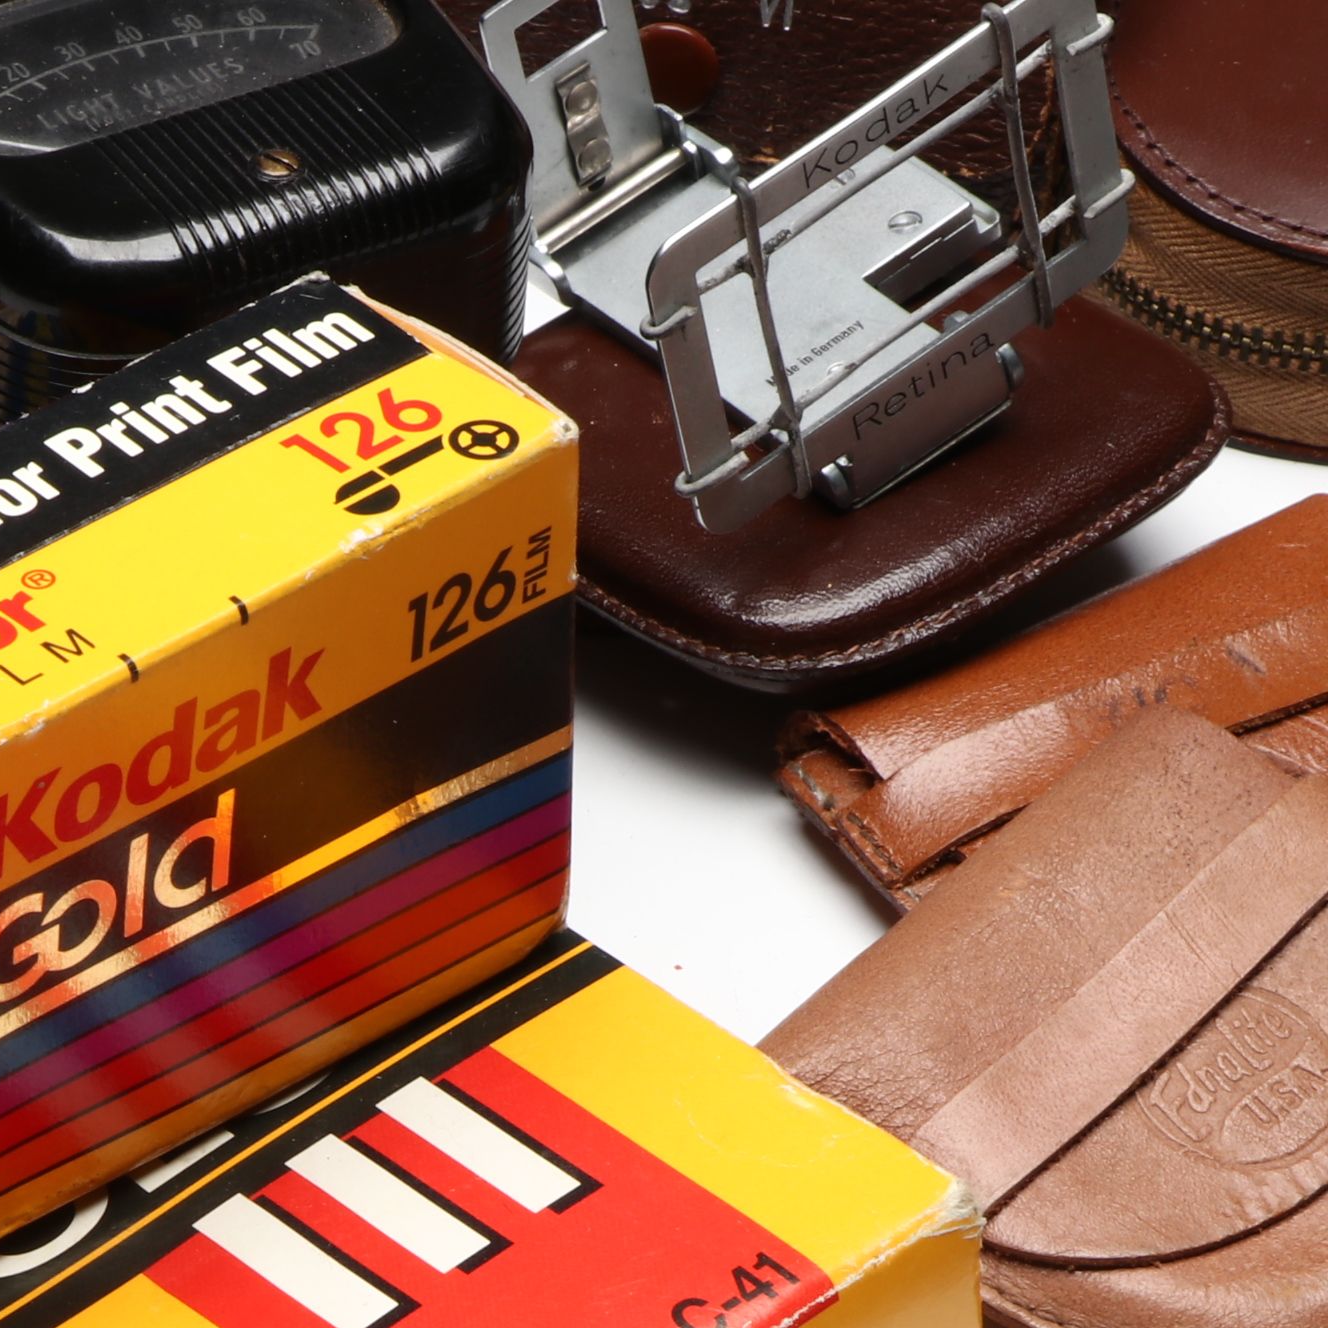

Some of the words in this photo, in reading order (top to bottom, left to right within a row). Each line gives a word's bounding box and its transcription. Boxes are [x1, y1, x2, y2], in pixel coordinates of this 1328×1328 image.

[115, 25, 143, 45] 40
[172, 14, 203, 33] 50
[236, 7, 267, 26] 60
[0, 61, 30, 83] 20
[54, 41, 86, 62] 30
[289, 40, 322, 59] 70
[36, 93, 121, 130] LIGHT
[131, 57, 246, 100] VALUES
[803, 71, 949, 192] Kodak
[797, 355, 814, 366] in
[810, 320, 864, 357] Germany
[44, 374, 232, 478] Print
[206, 311, 375, 395] Film
[852, 332, 995, 440] Retina
[279, 388, 443, 475] 126
[408, 546, 517, 662] 126
[521, 526, 552, 604] FILM
